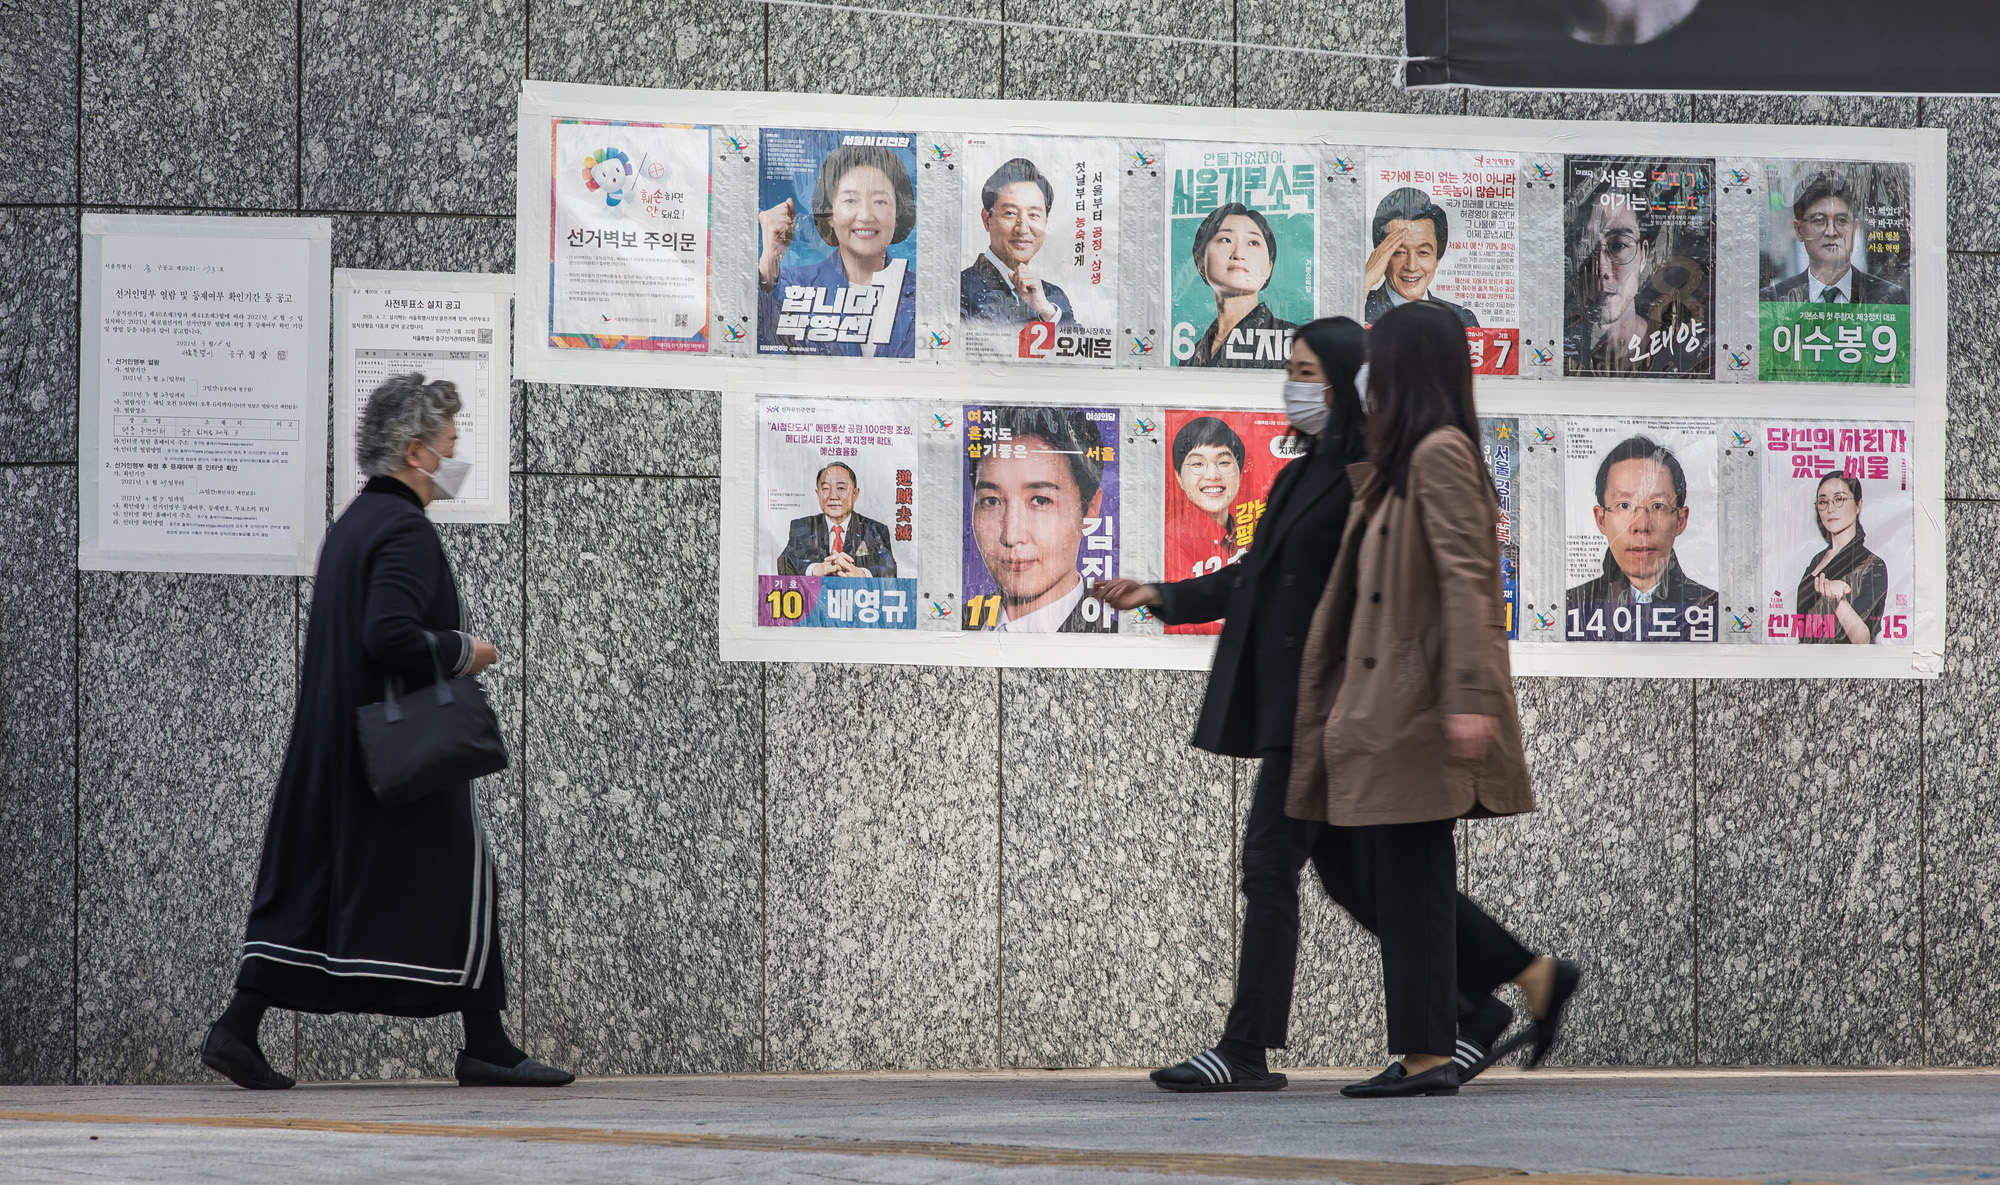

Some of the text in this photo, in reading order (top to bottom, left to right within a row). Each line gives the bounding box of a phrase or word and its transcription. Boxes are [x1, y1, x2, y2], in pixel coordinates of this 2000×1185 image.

[843, 136, 909, 147] 서울시 대전환
[1380, 171, 1516, 185] 국가에 돈이 없는 것이 아니라
[1600, 169, 1704, 189] 서울은 무지개
[640, 189, 684, 204] 훼손하면
[1093, 172, 1102, 221] 서울부터
[1172, 165, 1314, 214] 서울기본소득
[1432, 186, 1514, 199] 도둑놈이 많습니다
[1446, 199, 1514, 210] 국가 미래를 내다보는
[1600, 193, 1647, 211] 이기는
[647, 206, 684, 219] 안 돼요!
[1074, 162, 1086, 267] 첫날부터 능숙하게
[1460, 210, 1488, 219] 허경영이
[567, 228, 696, 251] 선거벽보 주의문
[1467, 230, 1481, 239] 이제
[1868, 231, 1900, 241] 서민 행복
[1449, 241, 1467, 249] 서울시
[1868, 243, 1900, 253] 서울 혁명
[115, 288, 293, 303] 선거인명부 열람 및 등재여부 확인기간 등 공고
[384, 299, 461, 309] 사전투표소 설치 공고
[782, 285, 878, 314] 합니다
[871, 259, 908, 344] 1
[1800, 312, 1824, 320] 기본소득
[1827, 312, 1833, 321] 첫
[1883, 313, 1896, 322] 대표
[776, 314, 870, 343] 박영선
[1059, 327, 1112, 336] 서울특별시장후보
[1030, 324, 1048, 356] 2
[1056, 337, 1112, 358] 오세훈
[1172, 322, 1195, 360] 6
[1628, 318, 1705, 363] 오태양
[1773, 324, 1897, 363] 이수봉 9
[1494, 340, 1512, 369] 7
[967, 409, 997, 424] 여자
[1086, 413, 1116, 422] 여성의당
[816, 424, 846, 434] 에덴동산
[848, 424, 863, 433] 공원
[865, 425, 893, 435] 100만평
[896, 425, 913, 435] 조성,
[967, 426, 1012, 441] 혼자도
[786, 434, 823, 444] 메디컬시티
[845, 436, 875, 445] 복지정책
[1767, 428, 1907, 452] 당신의 자리가
[820, 447, 858, 456] 예산효율화
[967, 443, 1116, 461] 살기좋은 서울
[1791, 455, 1835, 478] 있는
[1843, 455, 1889, 479] 서울
[767, 588, 908, 622] 10 배영규
[967, 595, 1001, 626] 11
[1567, 605, 1713, 641] 14 이도엽
[1768, 614, 1835, 638] 신지예
[1883, 615, 1908, 638] 15
